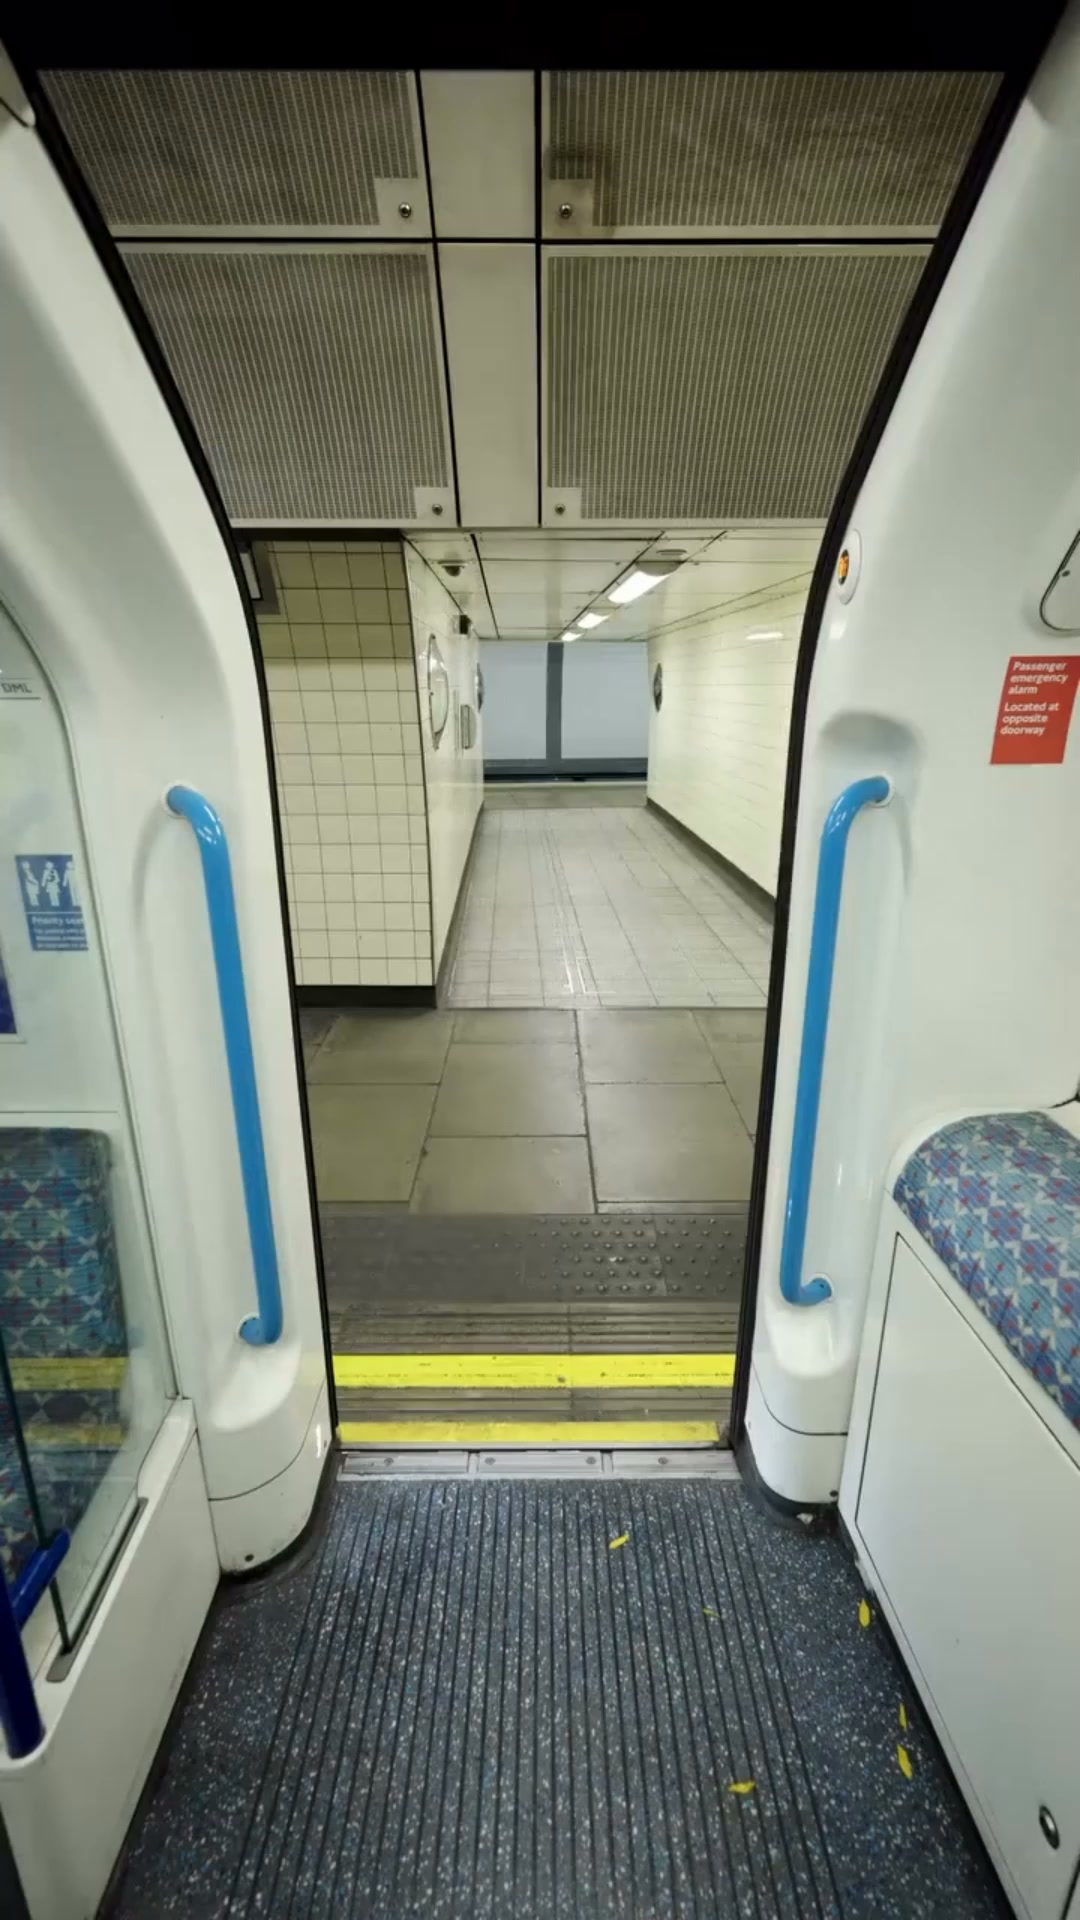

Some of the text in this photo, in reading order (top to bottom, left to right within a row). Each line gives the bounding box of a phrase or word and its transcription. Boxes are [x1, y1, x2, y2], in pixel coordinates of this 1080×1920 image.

[1013, 661, 1067, 672] Passenger
[1010, 674, 1068, 684] emergency
[1008, 685, 1038, 695] alarm
[1004, 702, 1059, 712] Located at
[1002, 714, 1048, 724] opposite
[1000, 725, 1045, 736] doorway
